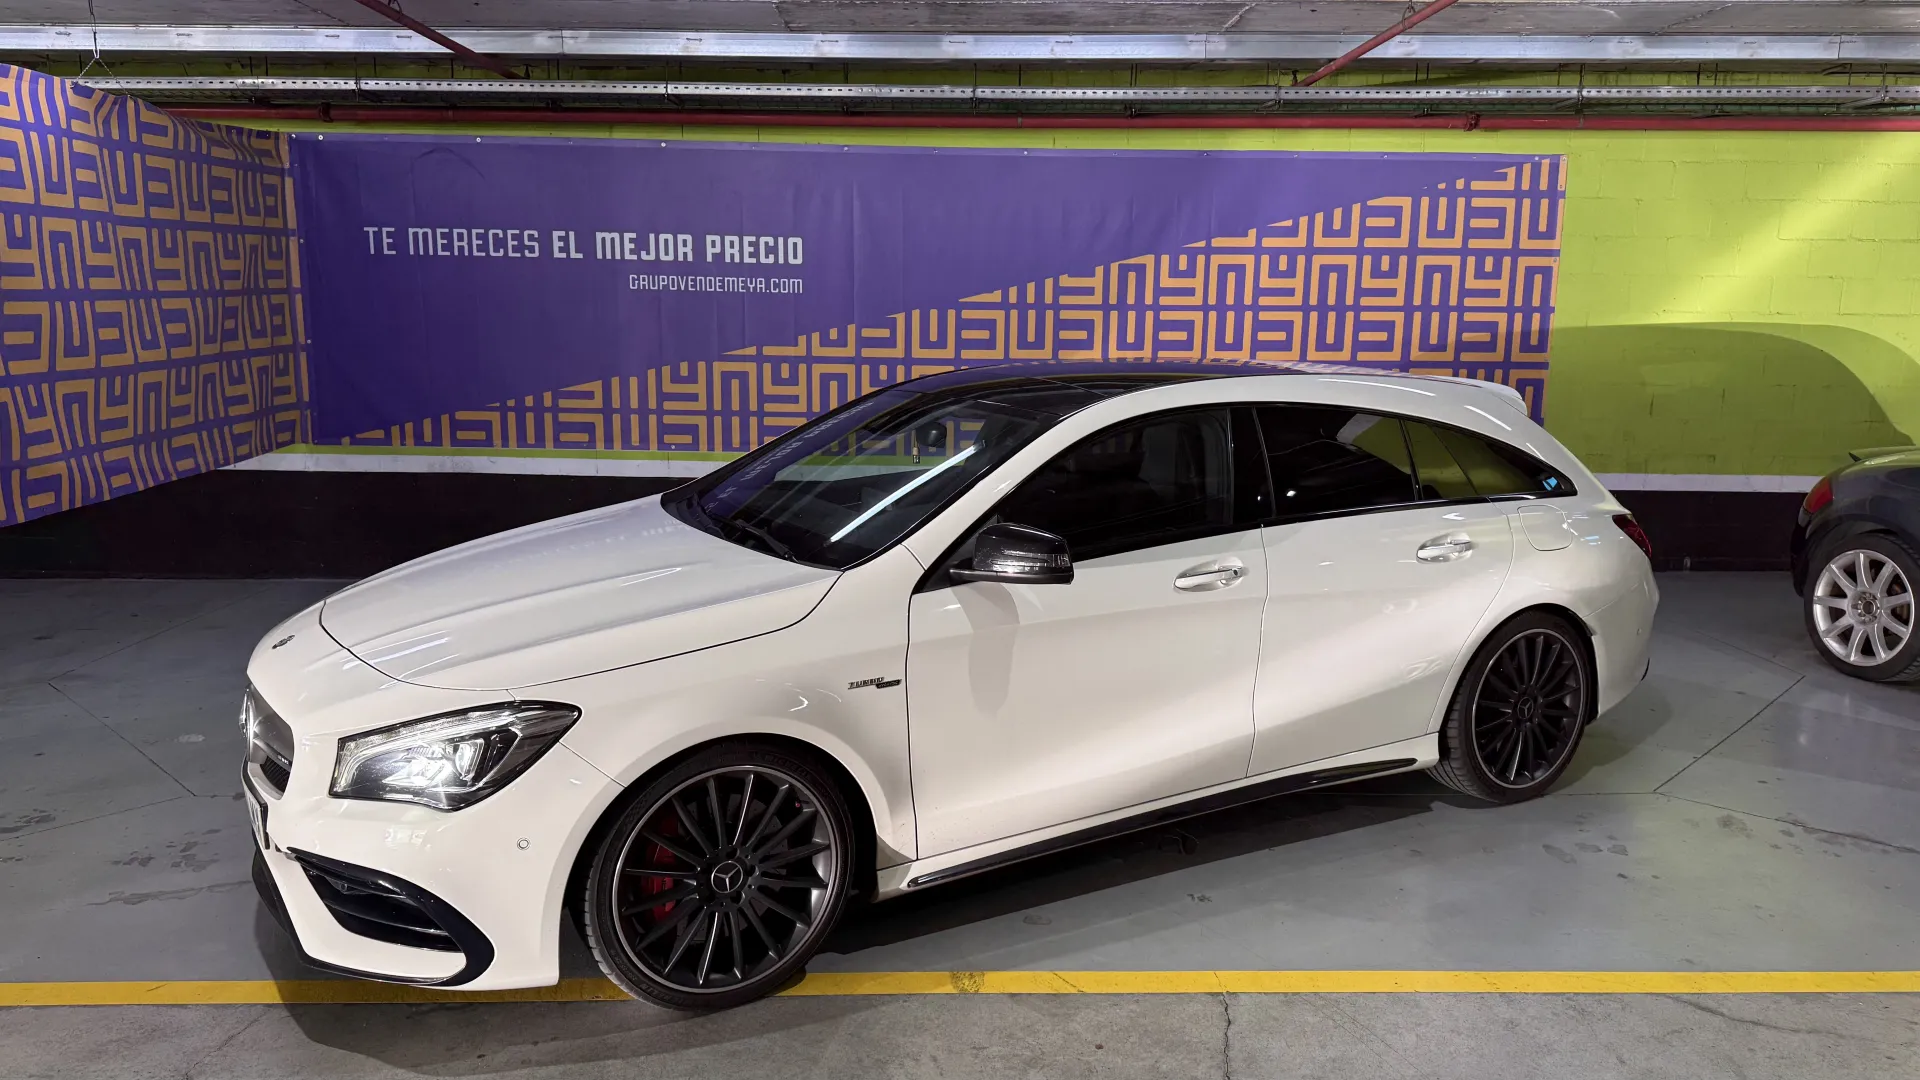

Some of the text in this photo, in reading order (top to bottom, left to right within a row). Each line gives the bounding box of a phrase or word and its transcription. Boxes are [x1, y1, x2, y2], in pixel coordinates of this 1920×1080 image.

[363, 226, 803, 265] TE MERECES EL MEJOR PRECIO
[629, 274, 803, 294] GRUPOVENDEMEYA.COM
